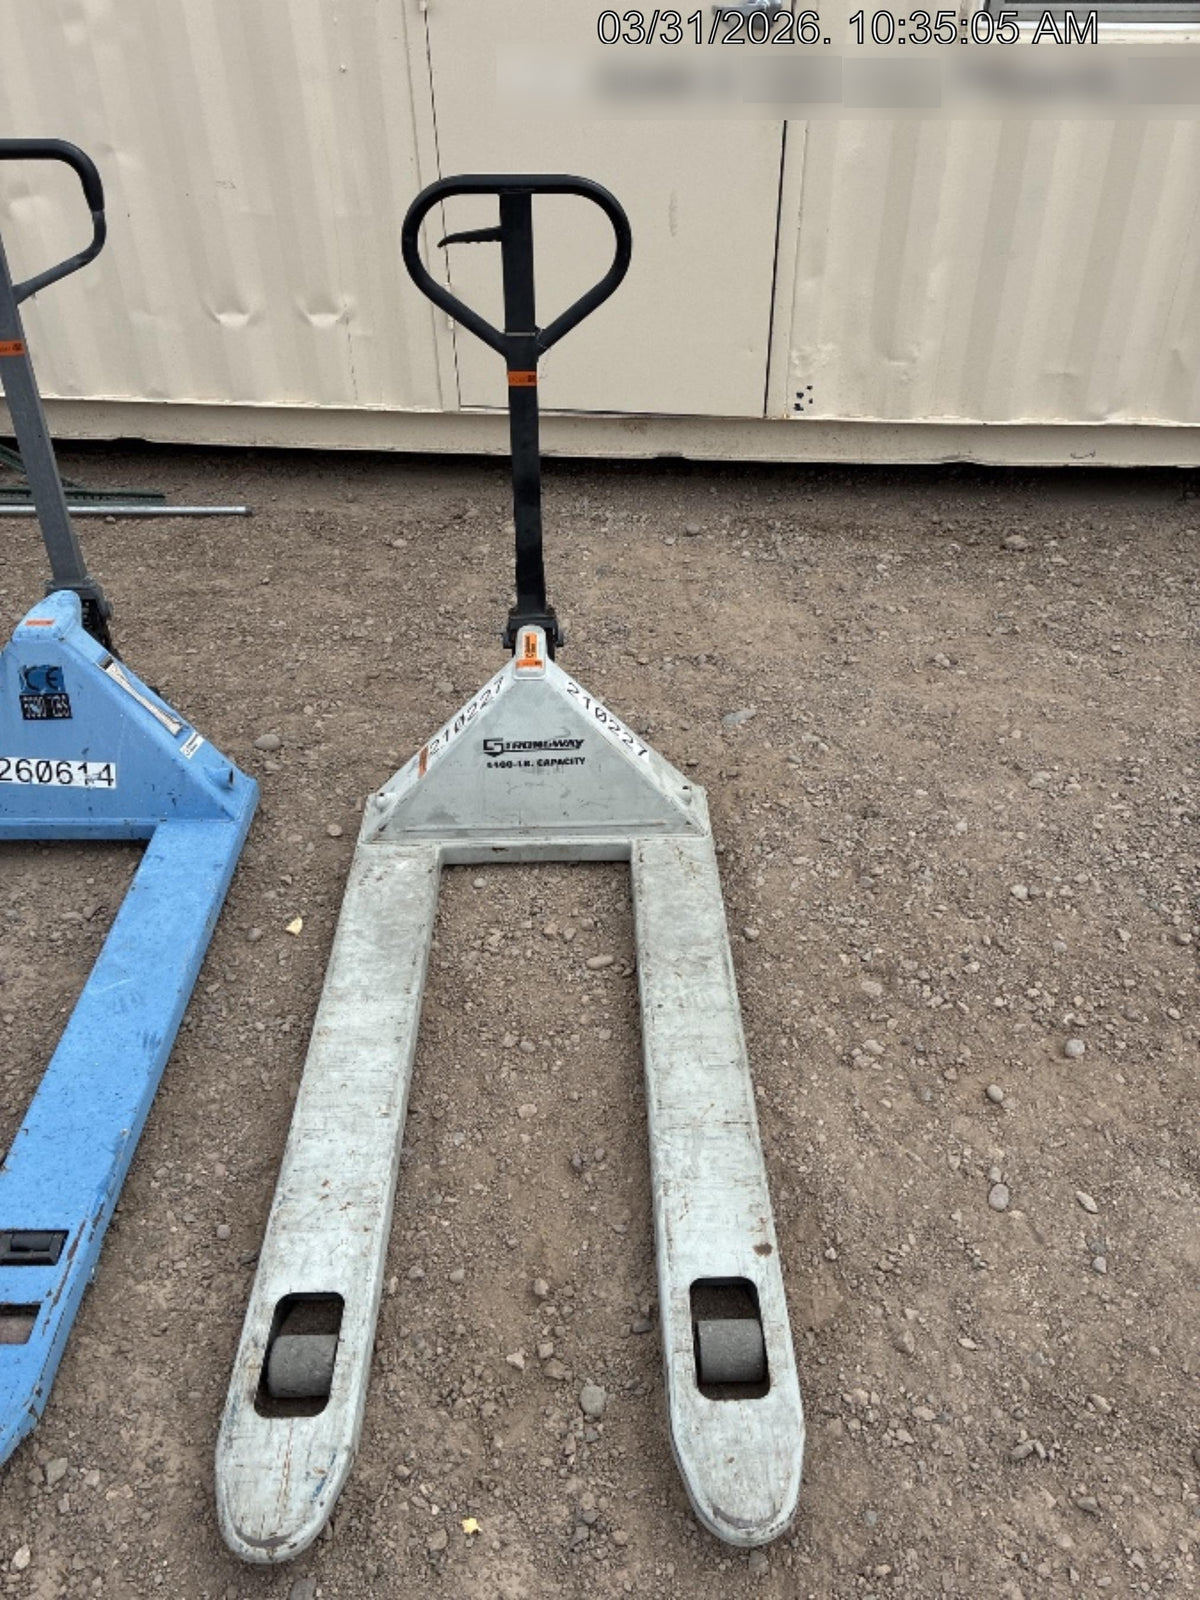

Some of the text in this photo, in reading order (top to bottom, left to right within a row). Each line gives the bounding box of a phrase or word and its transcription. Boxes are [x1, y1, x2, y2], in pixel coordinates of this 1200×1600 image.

[566, 682, 648, 756] 210227
[0, 758, 114, 787] 260614
[537, 757, 586, 767] CAPACITY
